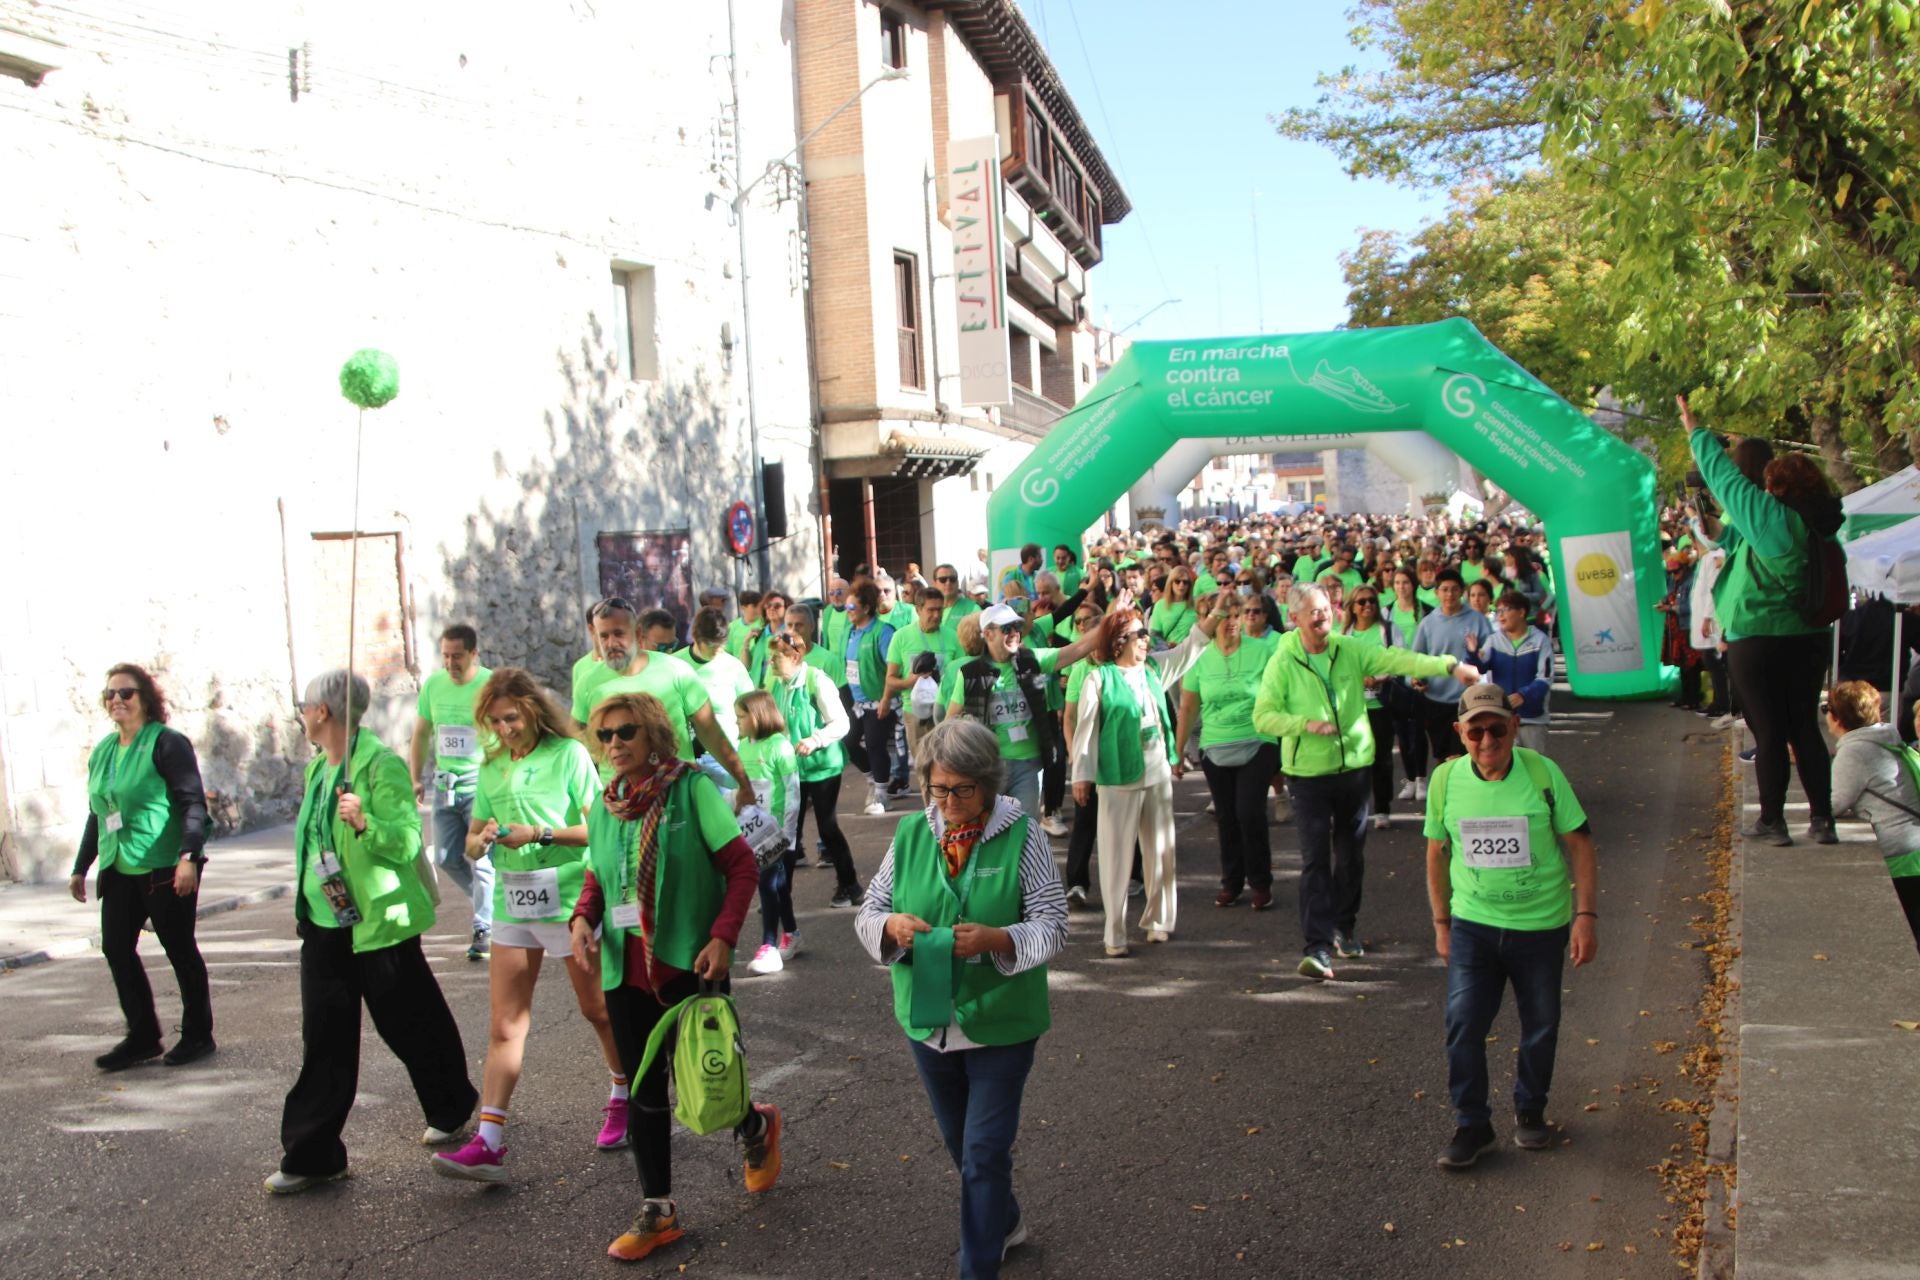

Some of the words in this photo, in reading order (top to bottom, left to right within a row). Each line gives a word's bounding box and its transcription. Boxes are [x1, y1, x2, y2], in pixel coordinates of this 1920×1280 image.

[1168, 347, 1197, 363] En
[1202, 343, 1290, 361] marcha
[1166, 365, 1240, 384] contra
[1167, 388, 1190, 407] el
[1194, 386, 1274, 407] cáncer
[1474, 421, 1489, 436] en
[1489, 432, 1528, 467] Segovia
[1482, 412, 1513, 442] contra
[1513, 436, 1526, 447] el
[1524, 443, 1557, 472] cáncer
[1491, 402, 1540, 442] asociación
[1541, 441, 1585, 477] española
[1057, 447, 1080, 470] contra
[1064, 467, 1077, 480] en
[1076, 435, 1110, 467] Segovia
[1577, 568, 1615, 581] uvesa
[995, 701, 1025, 715] 2129
[444, 737, 464, 748] 381
[1472, 838, 1520, 854] 2323
[509, 888, 550, 906] 1294
